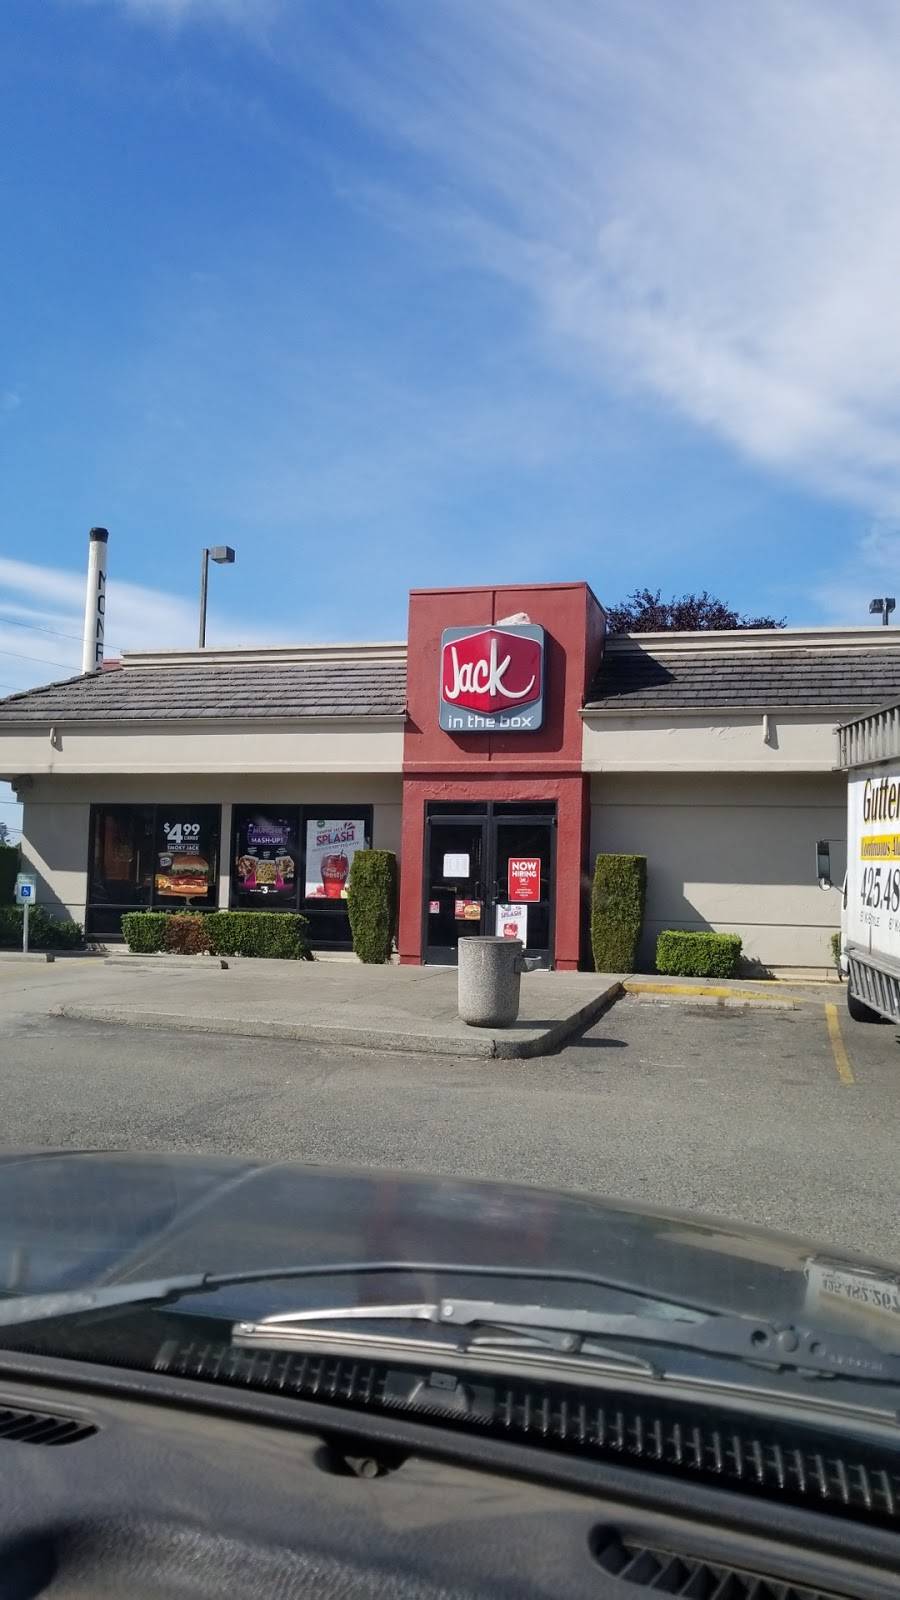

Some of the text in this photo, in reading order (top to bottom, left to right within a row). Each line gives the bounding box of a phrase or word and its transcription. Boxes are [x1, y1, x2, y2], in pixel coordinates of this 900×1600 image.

[445, 638, 536, 699] Jack
[448, 715, 533, 729] in the box
[316, 830, 355, 846] SPLASH
[511, 861, 537, 871] NOW
[511, 870, 537, 878] HIRING
